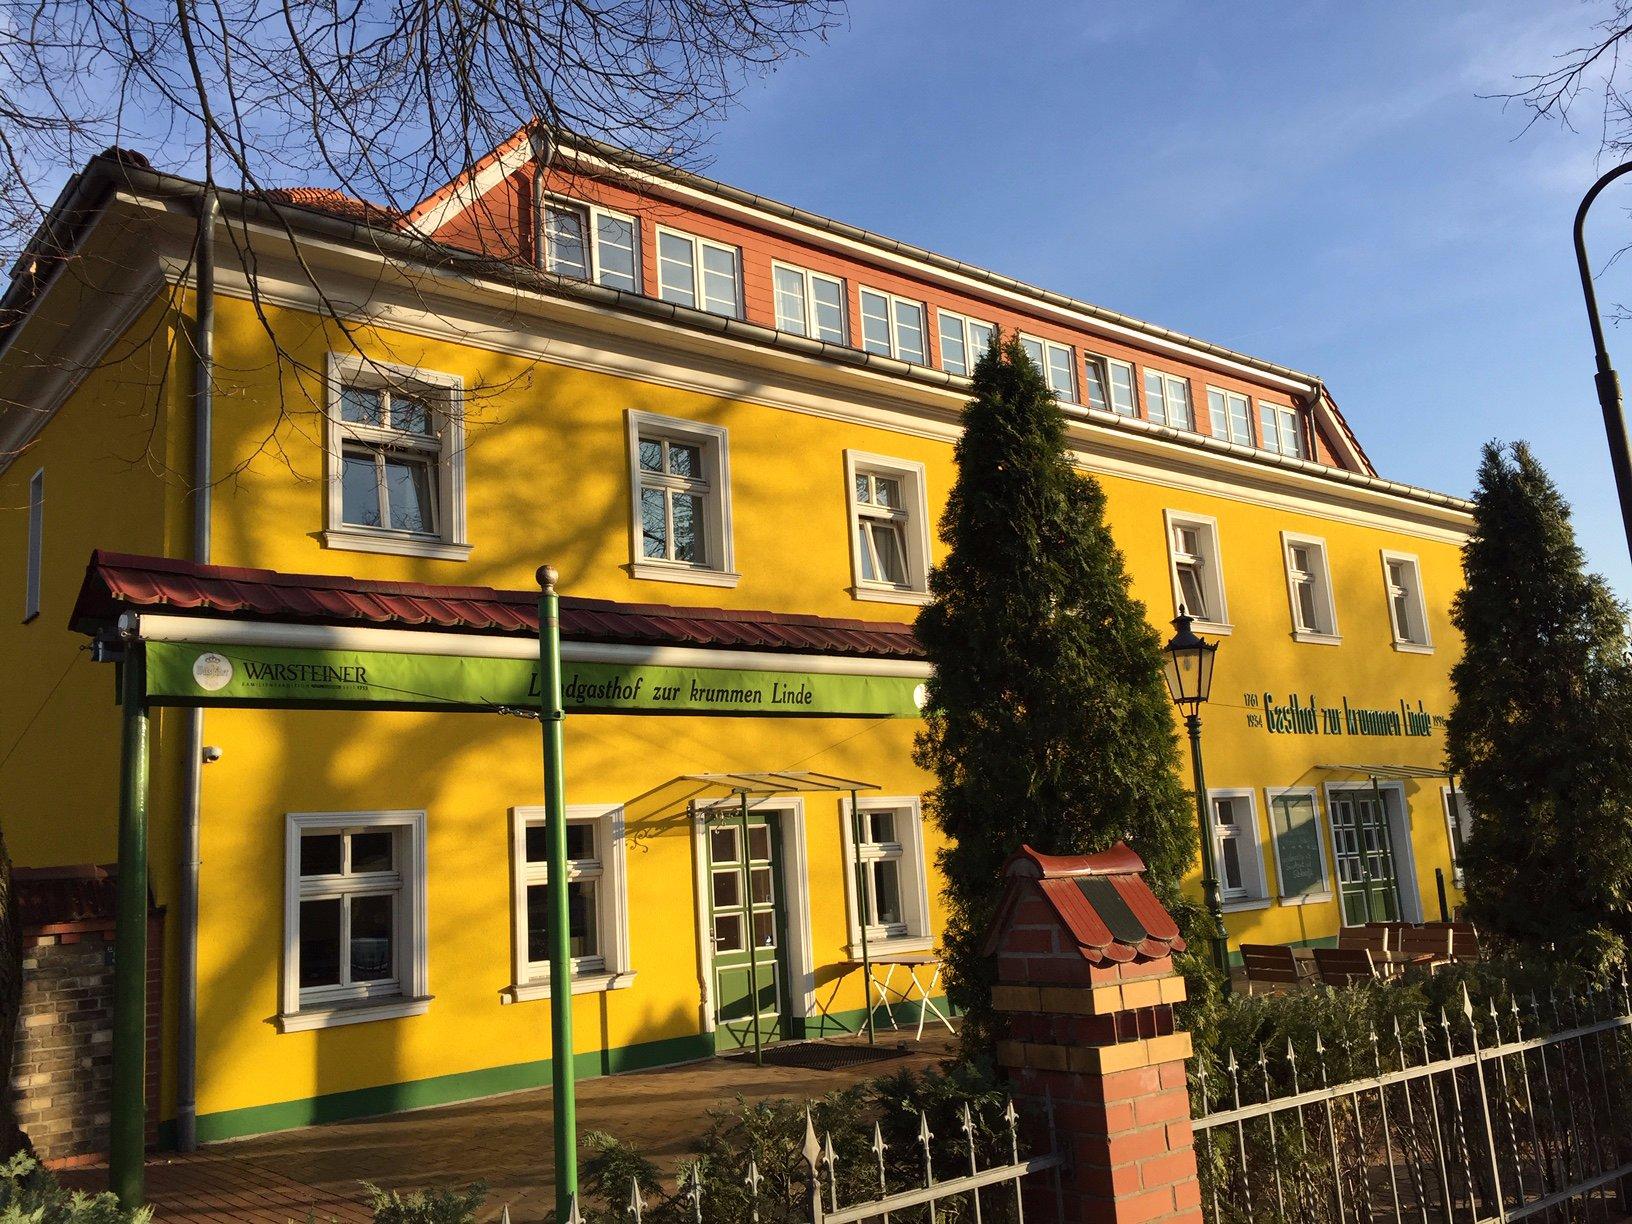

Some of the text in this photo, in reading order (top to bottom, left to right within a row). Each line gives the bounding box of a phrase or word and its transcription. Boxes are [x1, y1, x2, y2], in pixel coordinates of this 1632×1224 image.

[243, 662, 367, 683] WARSTEINER
[528, 673, 812, 704] Ldgasthof zur krummen Linde
[1244, 693, 1258, 707] 1761
[1263, 692, 1431, 736] Gasthof zur krummen Linde
